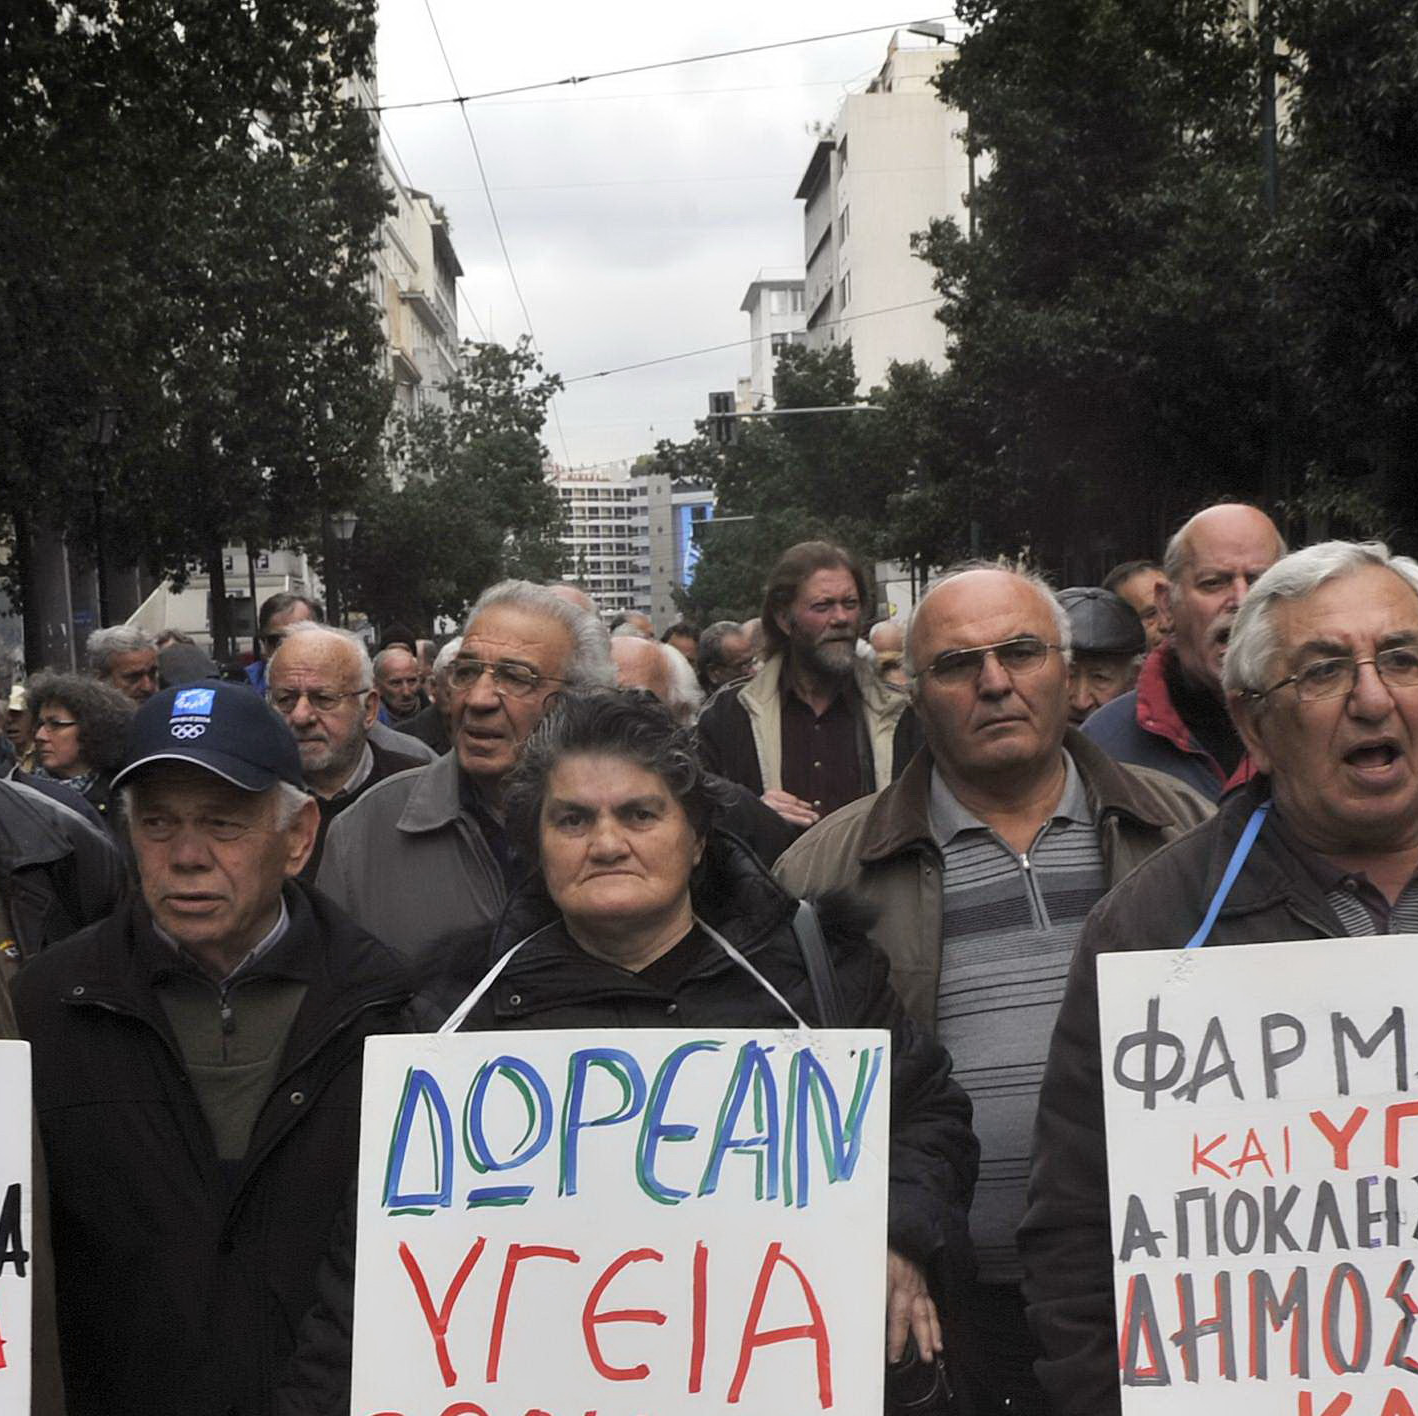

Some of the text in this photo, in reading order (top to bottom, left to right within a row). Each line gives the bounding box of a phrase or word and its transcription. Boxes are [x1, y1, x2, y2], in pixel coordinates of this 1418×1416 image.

[380, 1040, 885, 1217] ΔΩΡΕΑΝ
[1192, 1126, 1291, 1179] ΚΑΙ
[397, 1235, 835, 1410] ΥΓΕΙΑ
